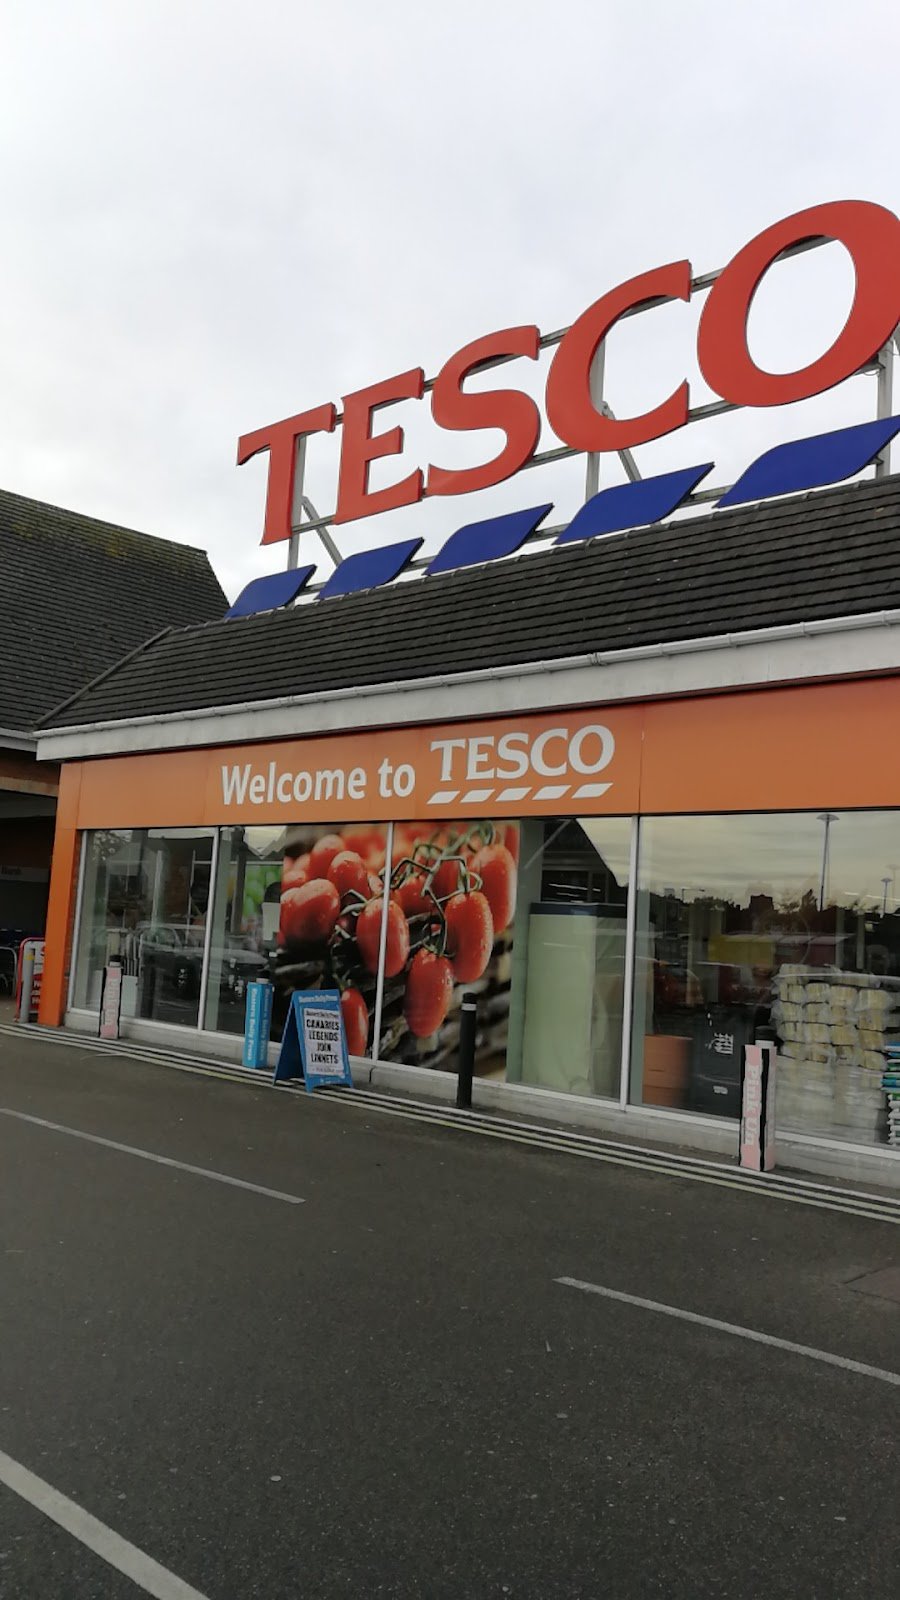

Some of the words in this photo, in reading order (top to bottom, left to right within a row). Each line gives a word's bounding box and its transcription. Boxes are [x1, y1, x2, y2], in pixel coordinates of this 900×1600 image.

[236, 199, 900, 545] TESCO
[221, 761, 367, 805] Welcome
[377, 757, 416, 798] to
[429, 724, 616, 782] TESCO
[306, 1019, 340, 1031] CANARIES
[308, 1030, 339, 1041] LEGENDS
[317, 1042, 332, 1052] JOIN
[311, 1054, 339, 1064] LINNETS
